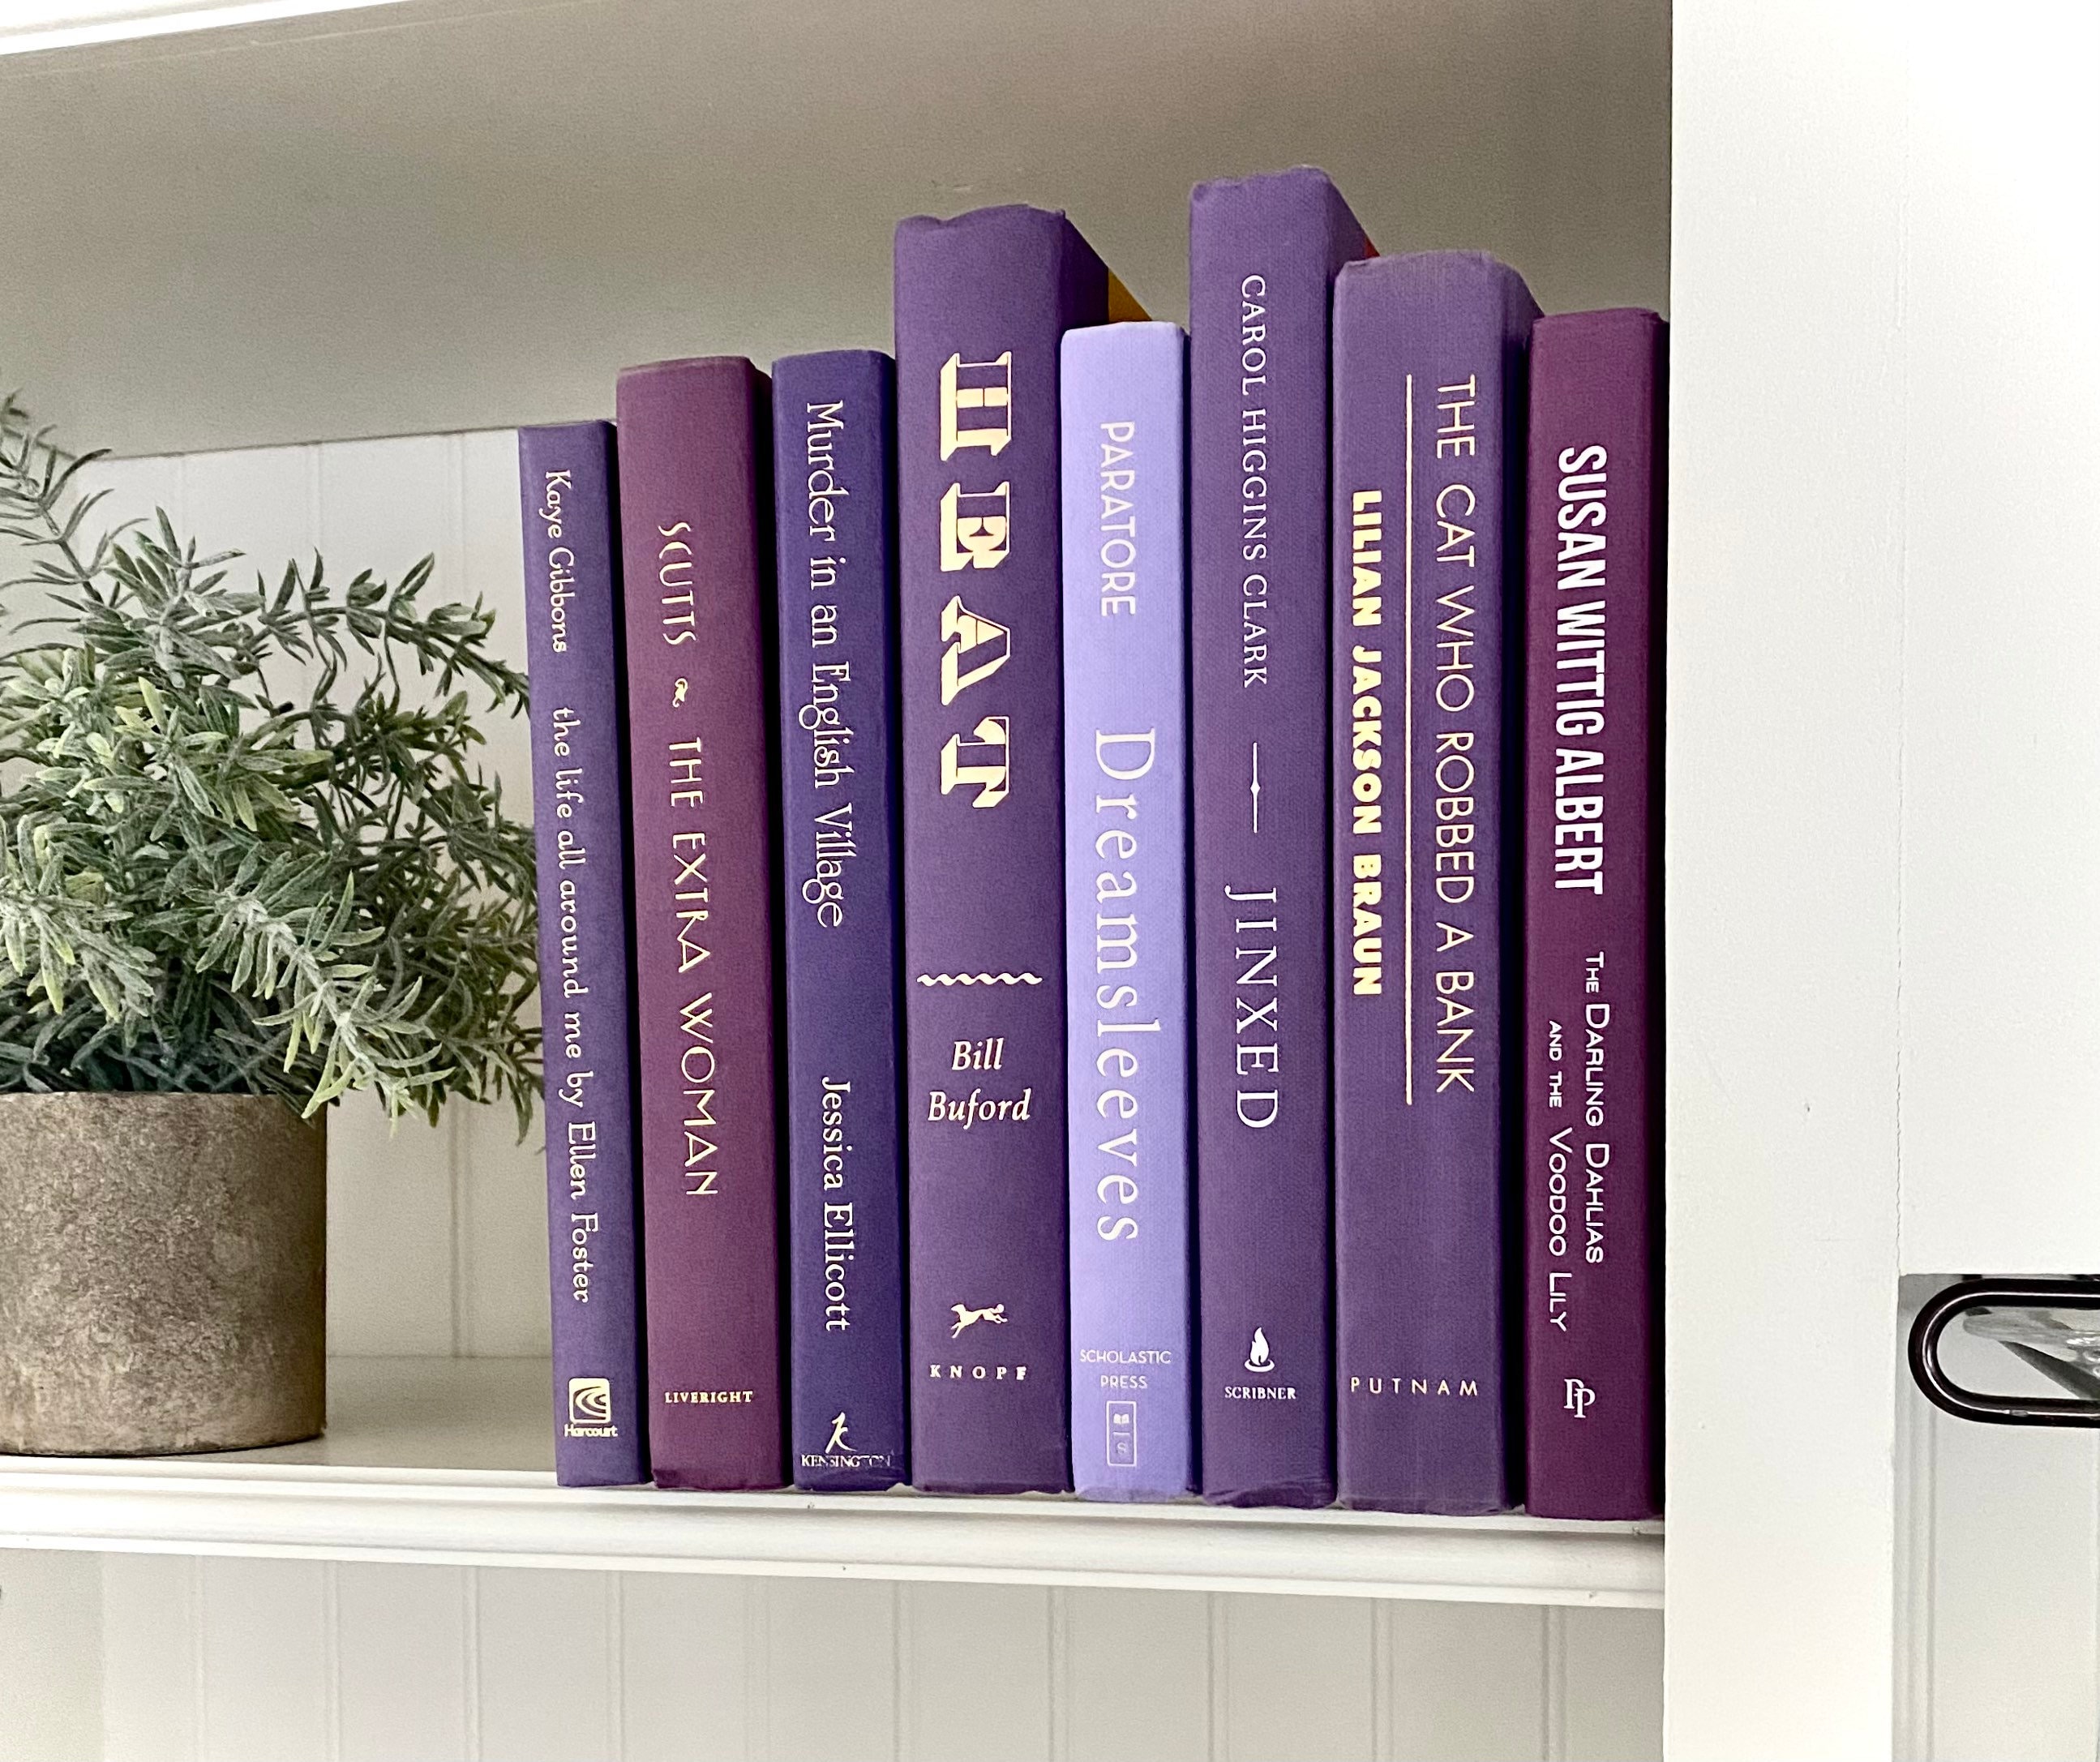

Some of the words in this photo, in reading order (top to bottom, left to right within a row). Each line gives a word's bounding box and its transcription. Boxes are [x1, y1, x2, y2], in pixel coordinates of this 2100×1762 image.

[1241, 275, 1267, 396] CAROL
[807, 400, 850, 542] Murder
[1437, 374, 1476, 459] THE
[538, 469, 572, 539] Kaye
[1100, 422, 1137, 617] PARATORE
[1242, 408, 1267, 561] HIGGINS
[1436, 484, 1476, 568] CAT
[1557, 445, 1608, 589] SUSAN
[548, 547, 576, 653] Gibbons
[658, 522, 696, 645] SCUTTS
[810, 556, 846, 591] in
[940, 351, 1012, 808] HEAT
[1352, 490, 1382, 627] LILIAN
[811, 605, 838, 649] an
[1243, 574, 1267, 688] CLARK
[1435, 585, 1476, 712] WHO
[1555, 600, 1606, 737] WITTIG
[553, 707, 581, 757] the
[668, 736, 704, 808] THE
[798, 661, 855, 789] English
[1352, 645, 1382, 834] JACKSON
[555, 768, 585, 819] life
[557, 830, 586, 870] all
[1435, 732, 1475, 903] ROBBED
[1554, 748, 1604, 895] ALBERT
[672, 833, 711, 973] EXTRA
[802, 802, 857, 928] Village
[559, 880, 589, 999] around
[1352, 854, 1382, 995] BRAUN
[1435, 922, 1474, 952] A
[564, 1012, 582, 1059] me
[1095, 728, 1161, 1241] Dreamsleeves
[1224, 885, 1279, 1128] JINXED
[1435, 971, 1475, 1093] BANK
[558, 1070, 594, 1108] by
[679, 992, 718, 1195] WOMAN
[927, 1087, 1031, 1130] Buford
[951, 1037, 1005, 1071] Bill
[568, 1121, 597, 1201] Ellen
[821, 1076, 853, 1191] Jessica
[571, 1212, 599, 1303] Foster
[824, 1202, 855, 1331] Ellicott
[664, 1391, 753, 1404] LIVERIGHT
[929, 1364, 1027, 1381] KNOPF
[1079, 1348, 1172, 1364] SCHOLASTIC
[1100, 1374, 1148, 1389] PRESS
[1224, 1386, 1296, 1400] SCRIBNER
[1351, 1376, 1478, 1396] PUTNAM
[564, 1423, 619, 1438] Harcourt
